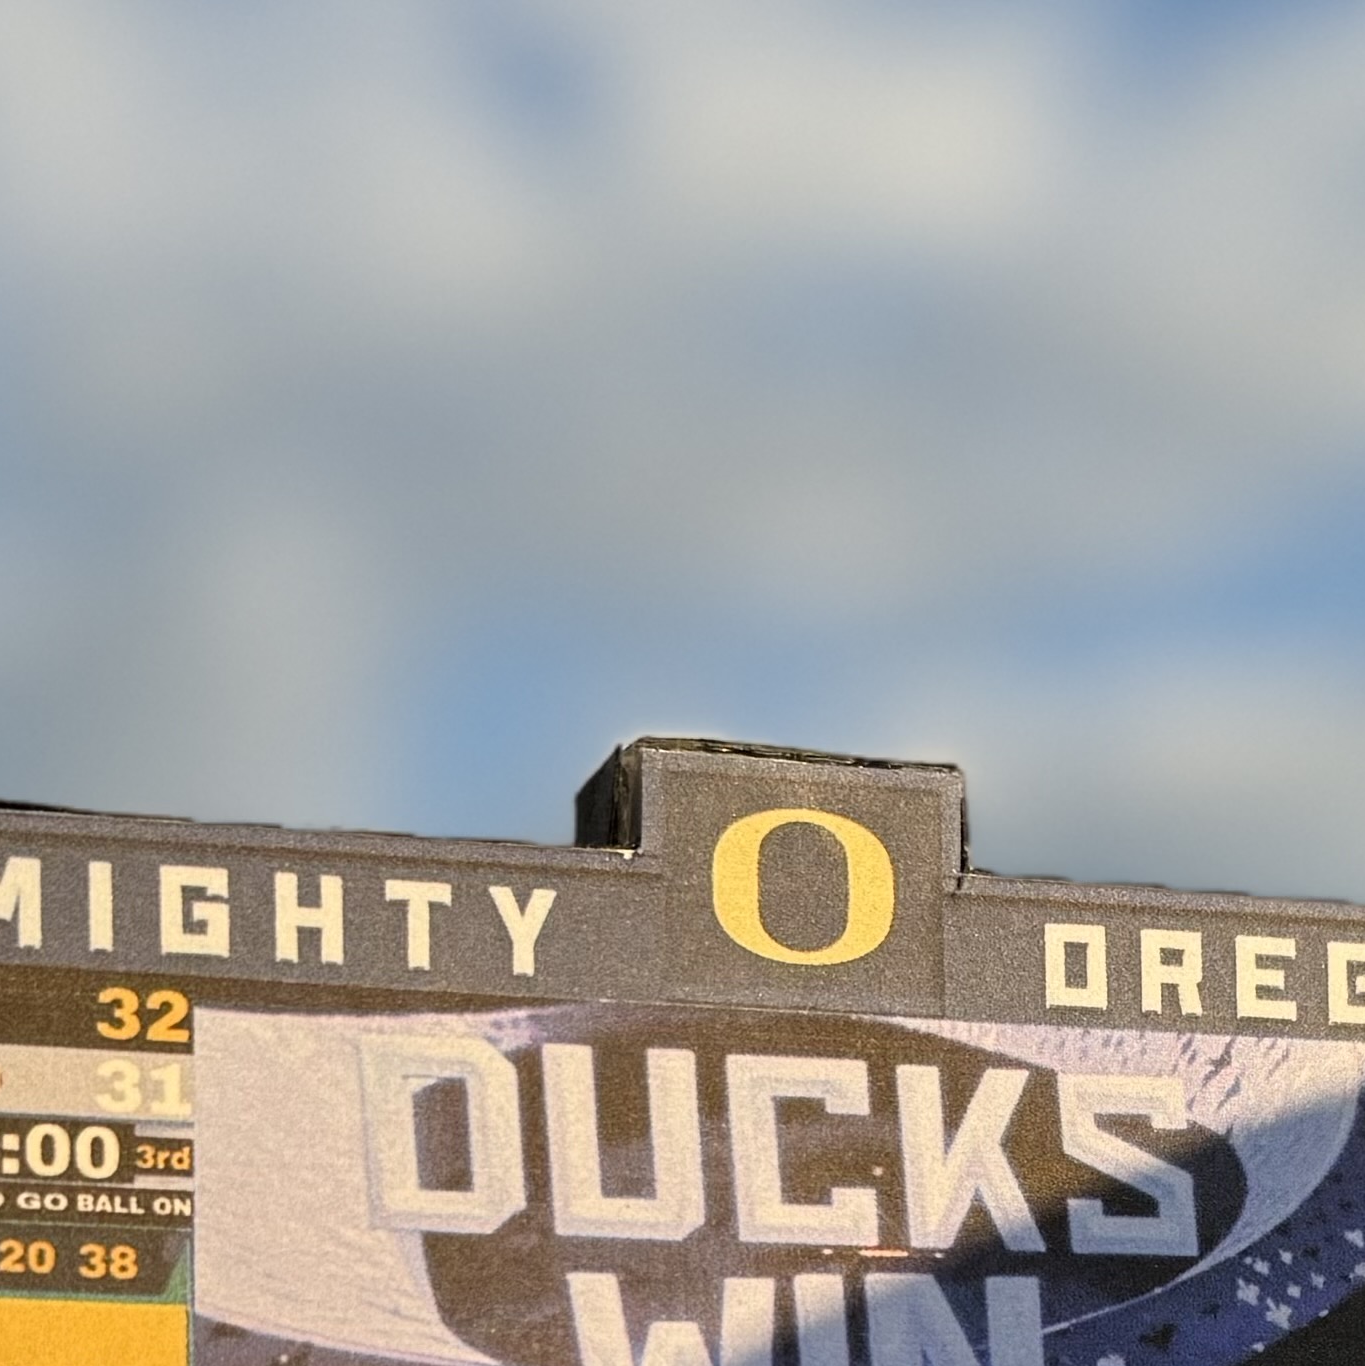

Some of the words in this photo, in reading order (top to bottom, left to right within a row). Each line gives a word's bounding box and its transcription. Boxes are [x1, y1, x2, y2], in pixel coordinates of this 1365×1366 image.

[711, 808, 895, 967] O
[96, 986, 191, 1044] 32
[96, 1058, 192, 1117] 31
[135, 1144, 192, 1171] 3rd
[357, 1033, 1202, 1258] DUCKS
[16, 1191, 68, 1212] GO
[76, 1193, 145, 1215] BALL
[152, 1197, 192, 1217] ON
[78, 1242, 139, 1280] 38
